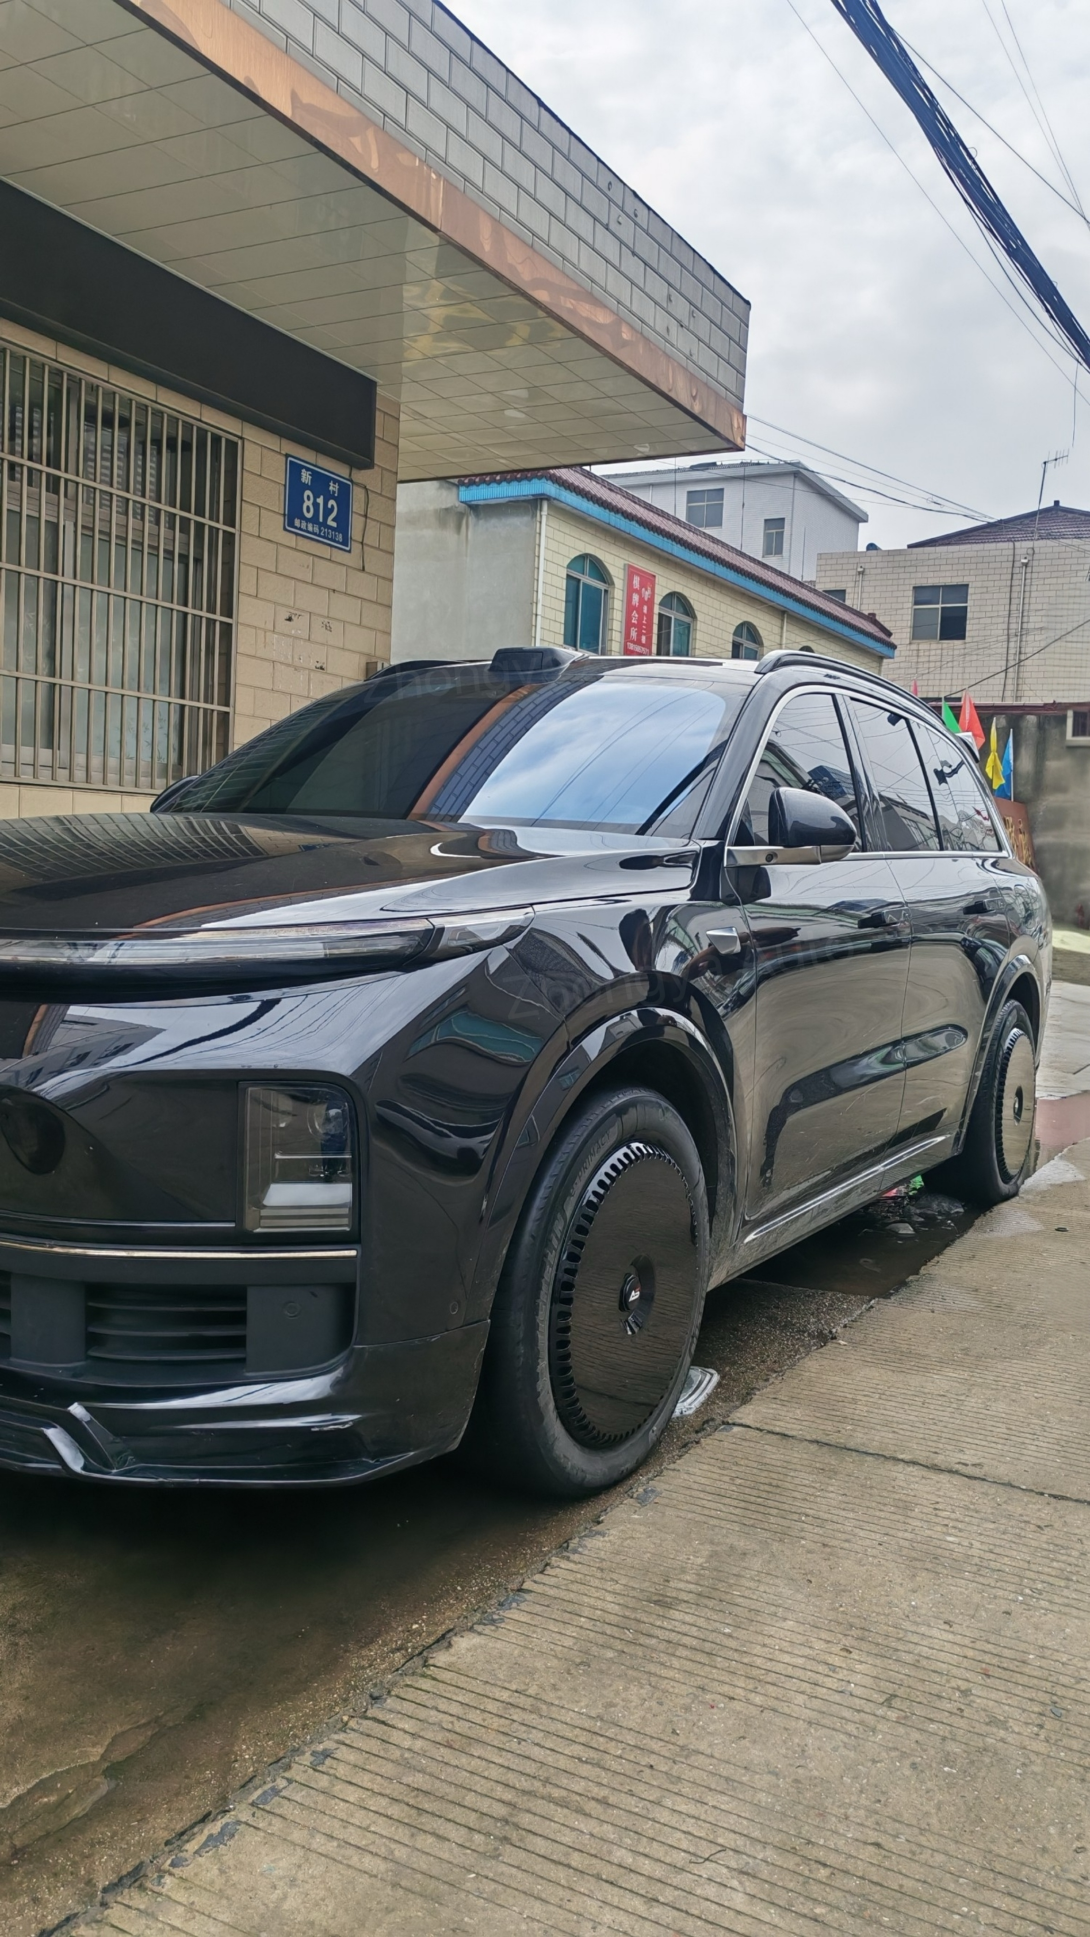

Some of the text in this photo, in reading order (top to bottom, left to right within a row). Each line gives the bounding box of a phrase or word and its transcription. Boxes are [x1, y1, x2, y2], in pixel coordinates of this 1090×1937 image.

[301, 469, 339, 496] 新村
[302, 489, 338, 528] 812
[294, 517, 343, 543] 邮政编码 213138
[630, 574, 640, 642] 棋牌会所
